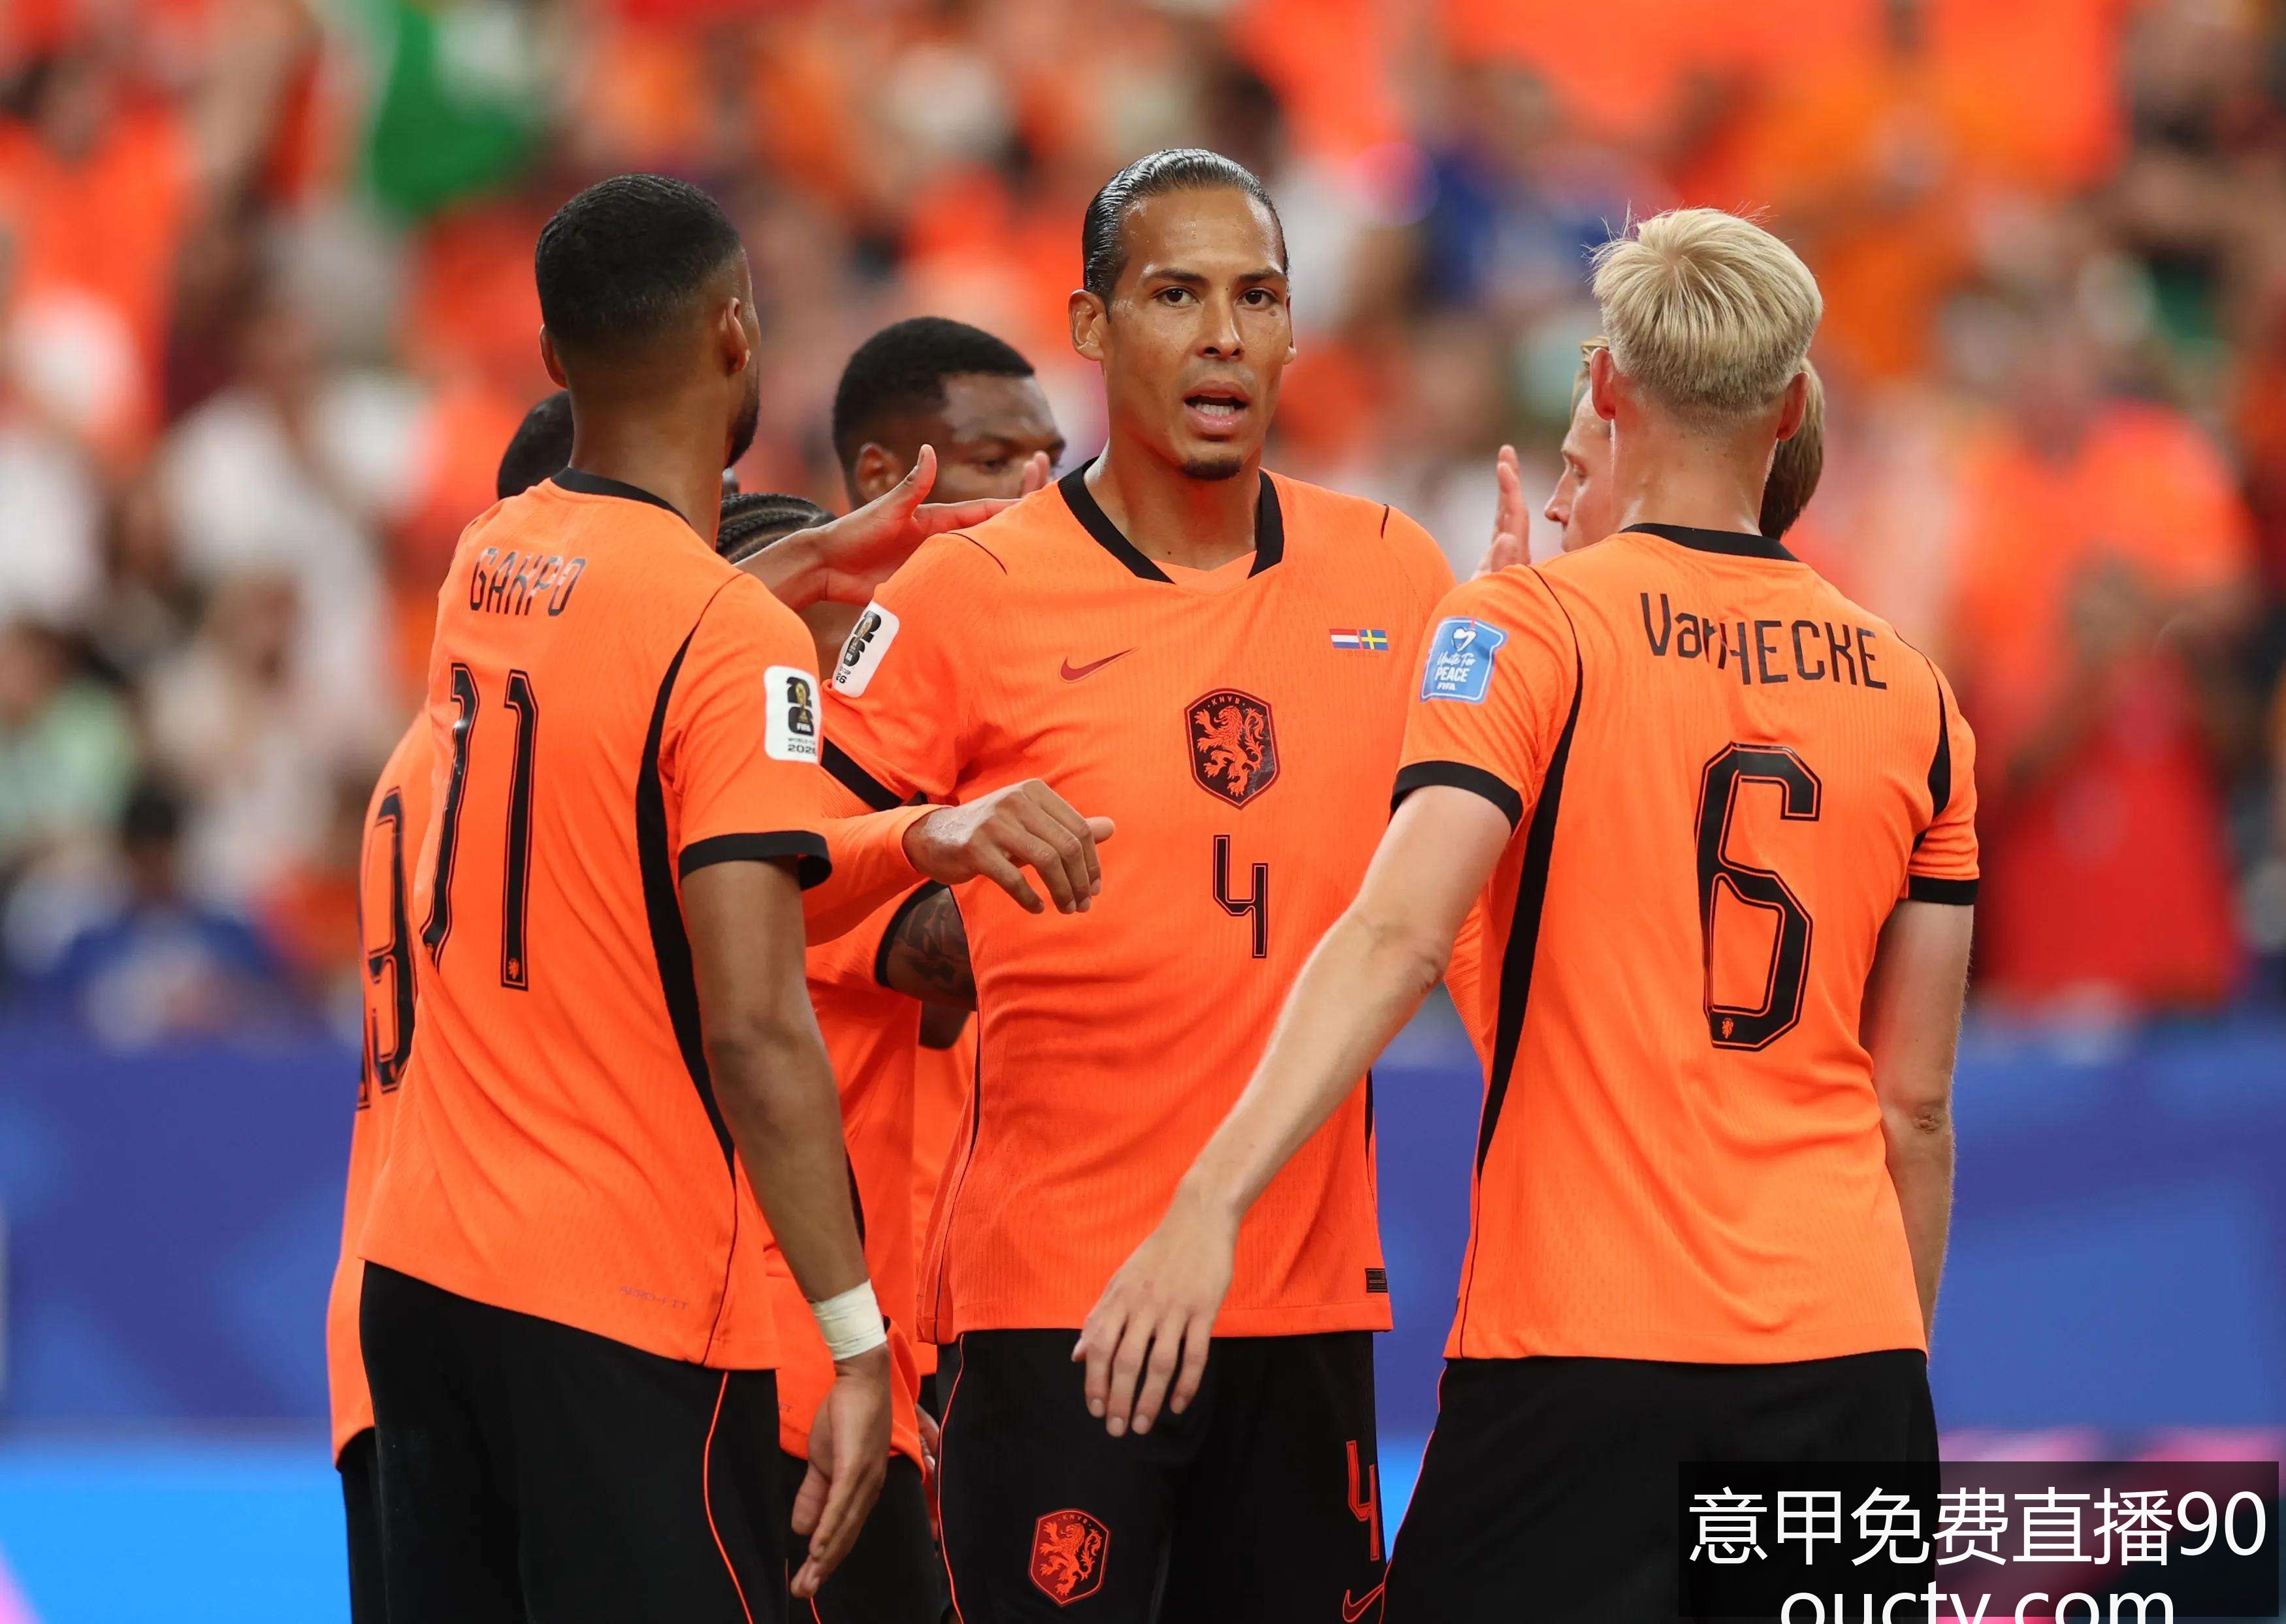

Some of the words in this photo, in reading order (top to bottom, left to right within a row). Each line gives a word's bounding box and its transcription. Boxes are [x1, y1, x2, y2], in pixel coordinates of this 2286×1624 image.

[470, 547, 587, 617] GAKPO
[836, 673, 847, 684] 26
[1434, 665, 1470, 682] PEACE
[1437, 682, 1456, 691] FIFA
[1717, 620, 1888, 690] HECKE
[1211, 696, 1240, 707] KNVB
[420, 661, 540, 992] 11
[1213, 834, 1269, 959] 4
[1695, 739, 1822, 1053] 6
[1062, 1514, 1088, 1525] KNVB
[1346, 1440, 1380, 1561] 4
